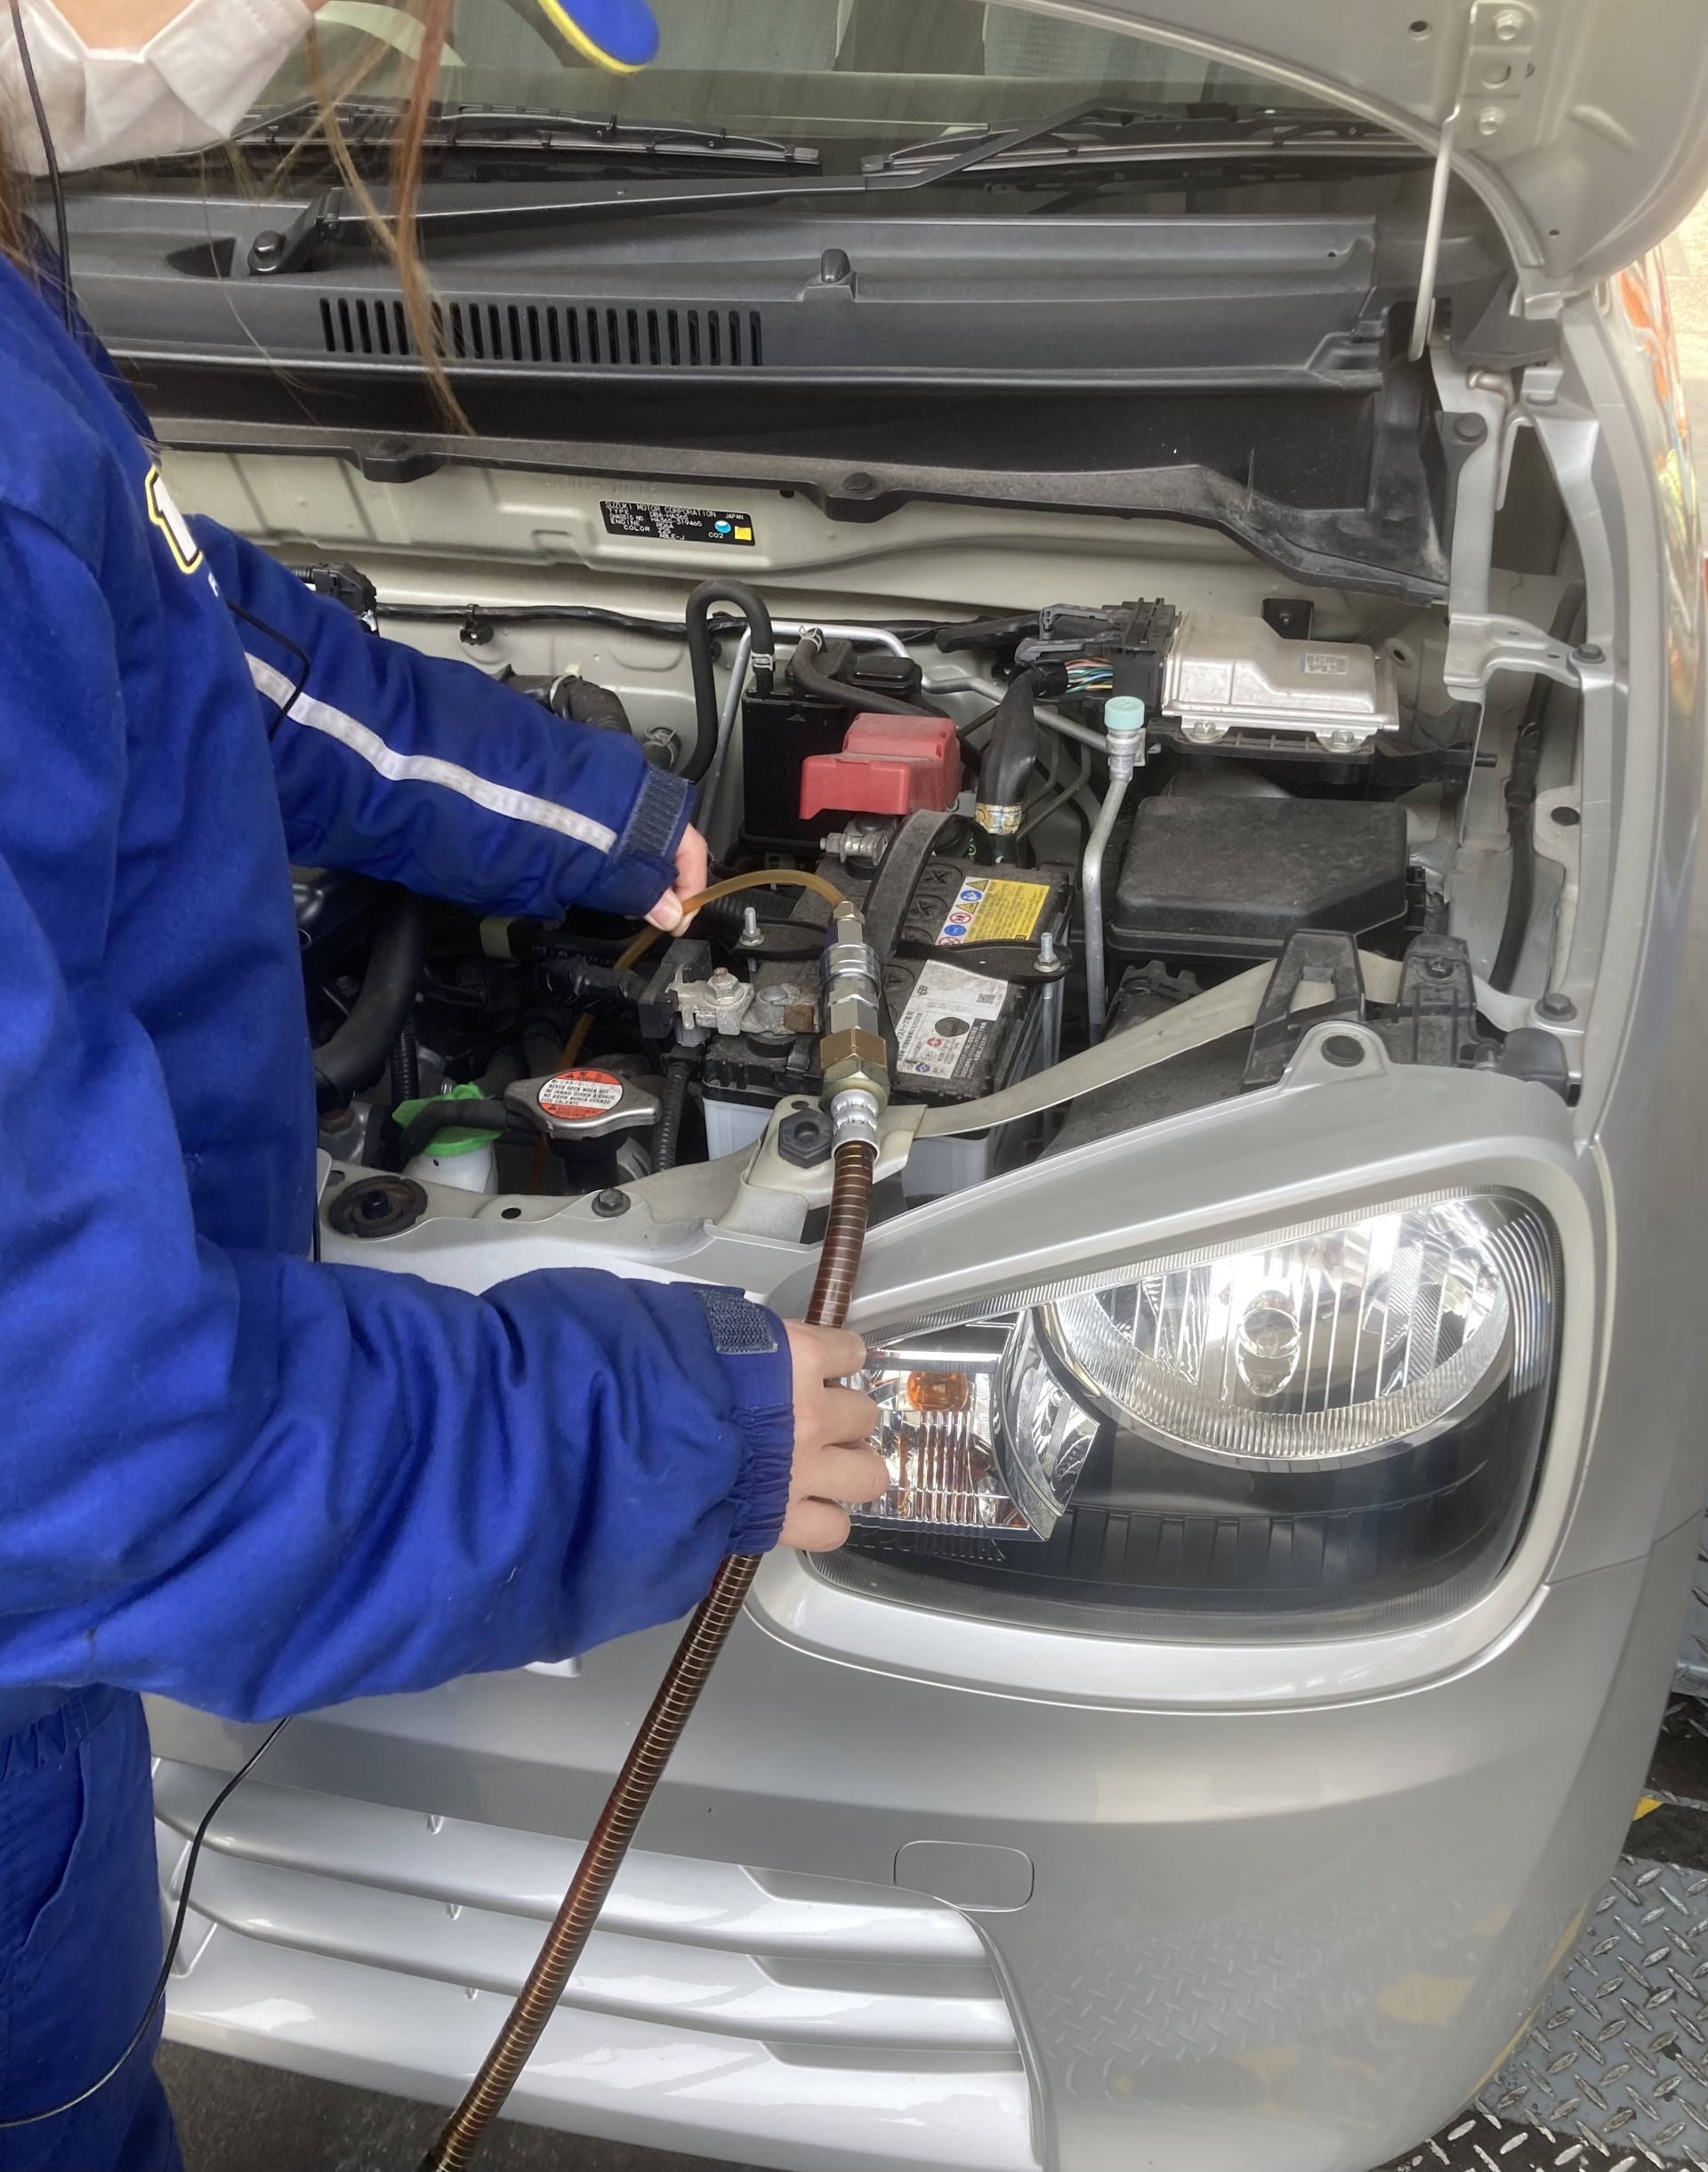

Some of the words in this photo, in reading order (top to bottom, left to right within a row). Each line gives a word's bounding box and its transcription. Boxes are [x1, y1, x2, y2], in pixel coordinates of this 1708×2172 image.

[605, 501, 632, 510] SUZUKI
[636, 503, 661, 512] MOTOR
[665, 506, 717, 518] CORPORATION
[610, 518, 640, 527] ENGINE
[623, 524, 650, 532] COLOR
[708, 531, 724, 539] CO2
